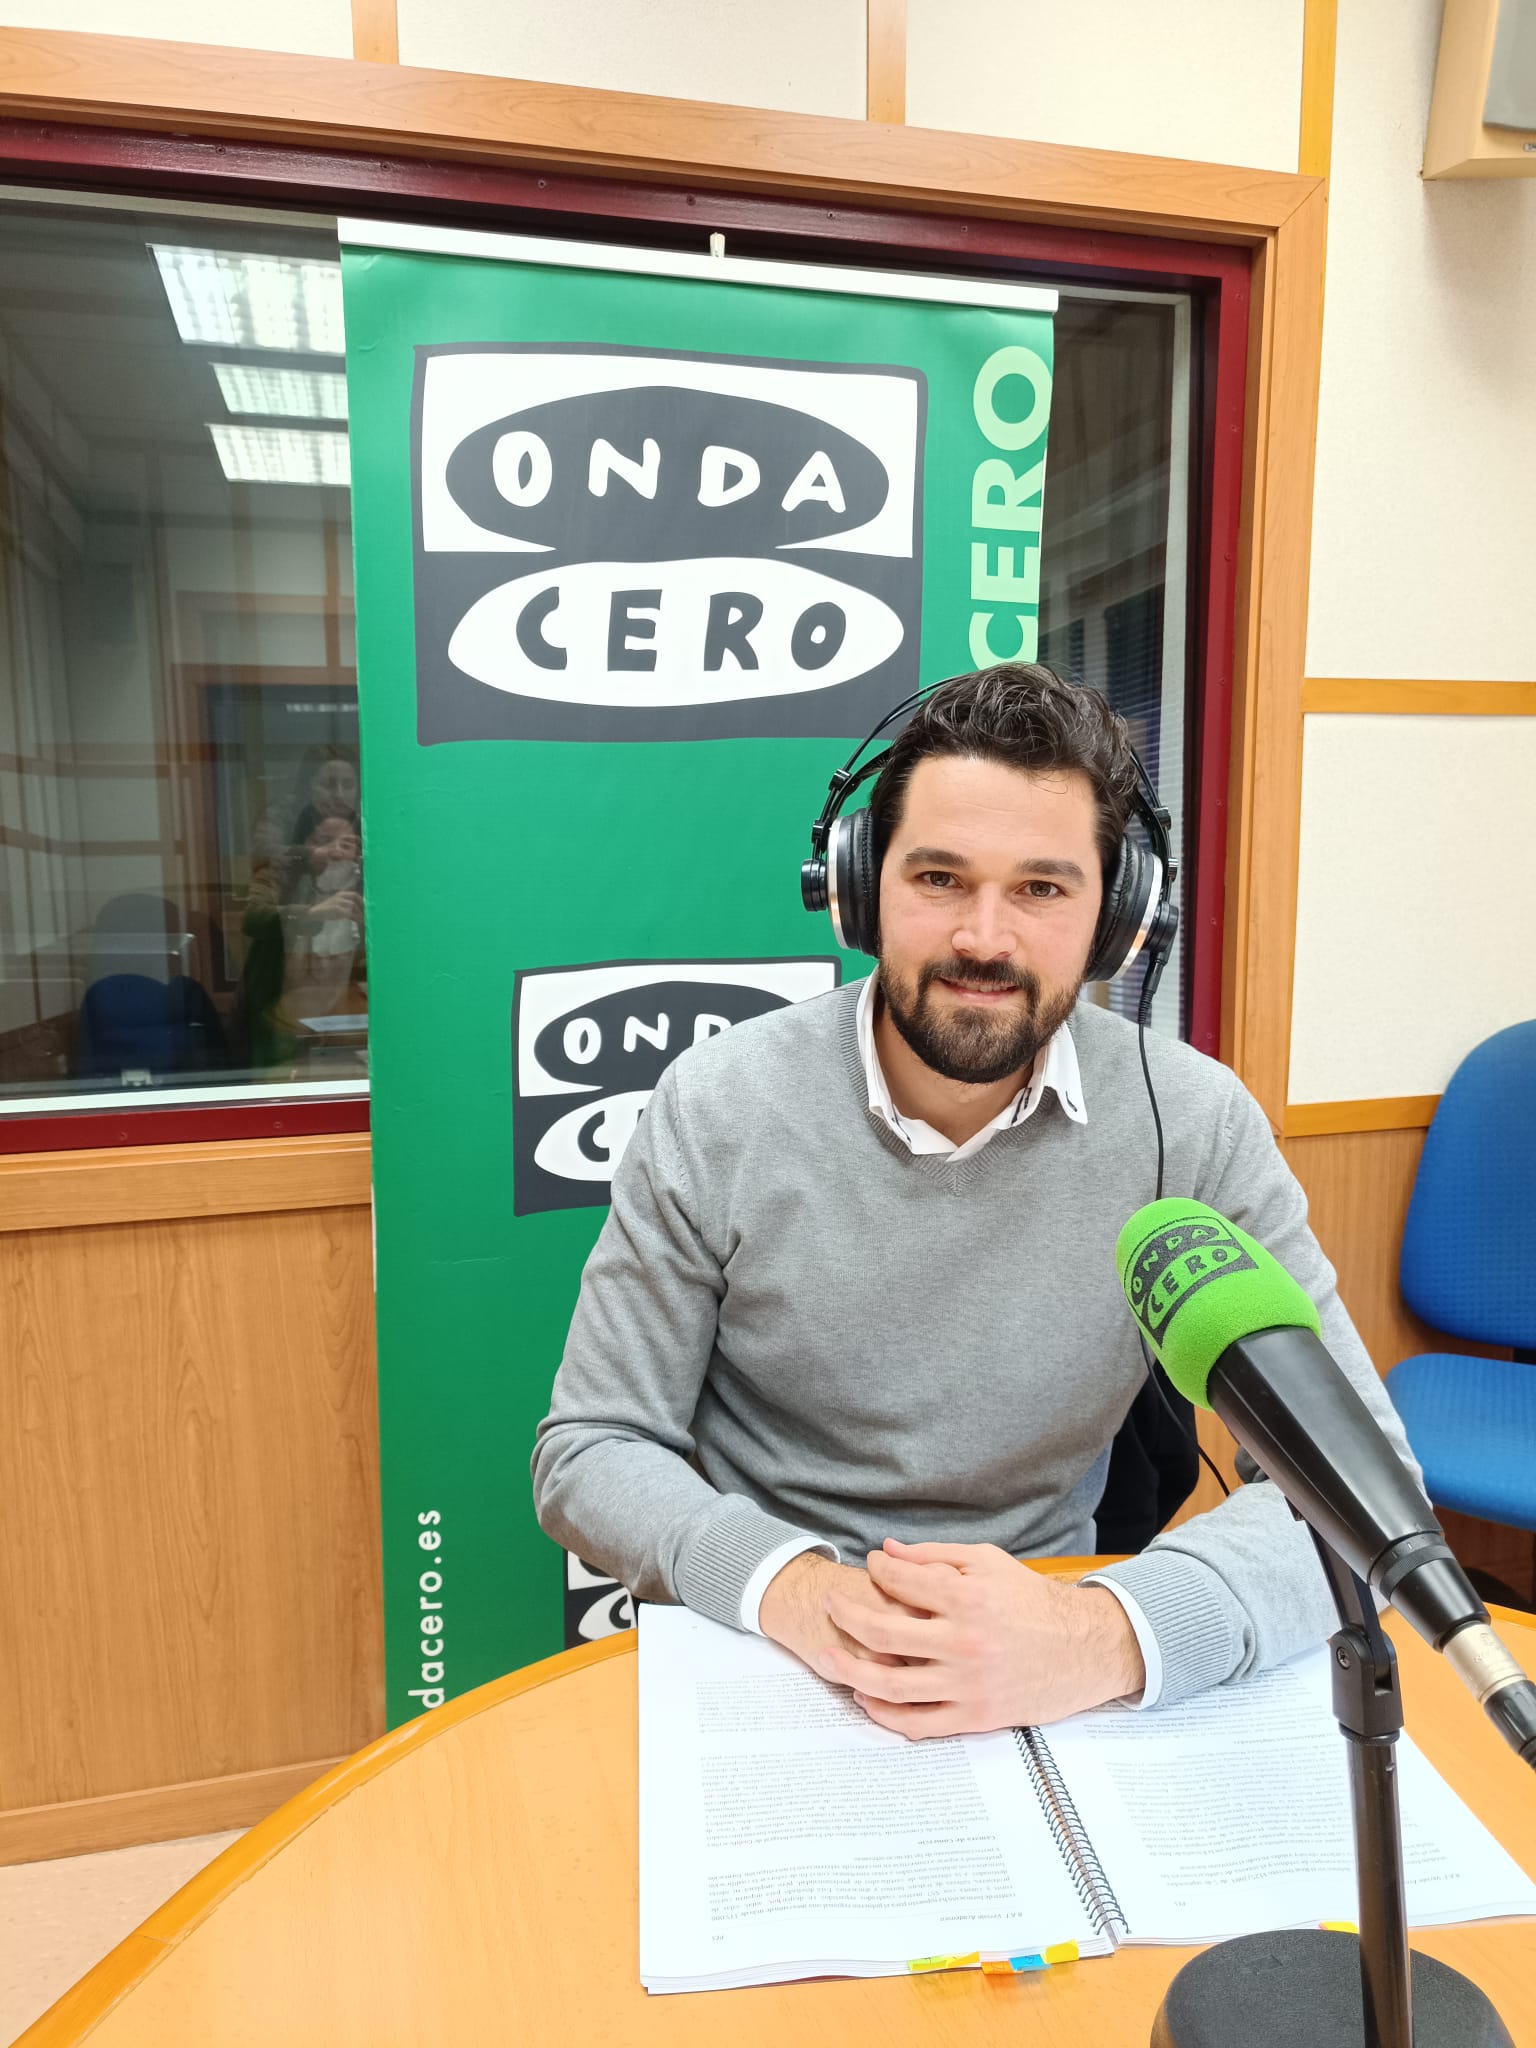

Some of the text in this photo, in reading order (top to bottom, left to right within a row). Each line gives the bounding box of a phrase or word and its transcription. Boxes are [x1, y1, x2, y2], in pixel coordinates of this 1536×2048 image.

[492, 430, 846, 513] ONDA
[515, 585, 847, 673] CERO
[562, 1012, 733, 1065] OND
[1131, 1228, 1210, 1294] ONDA
[1149, 1248, 1228, 1314] CERO
